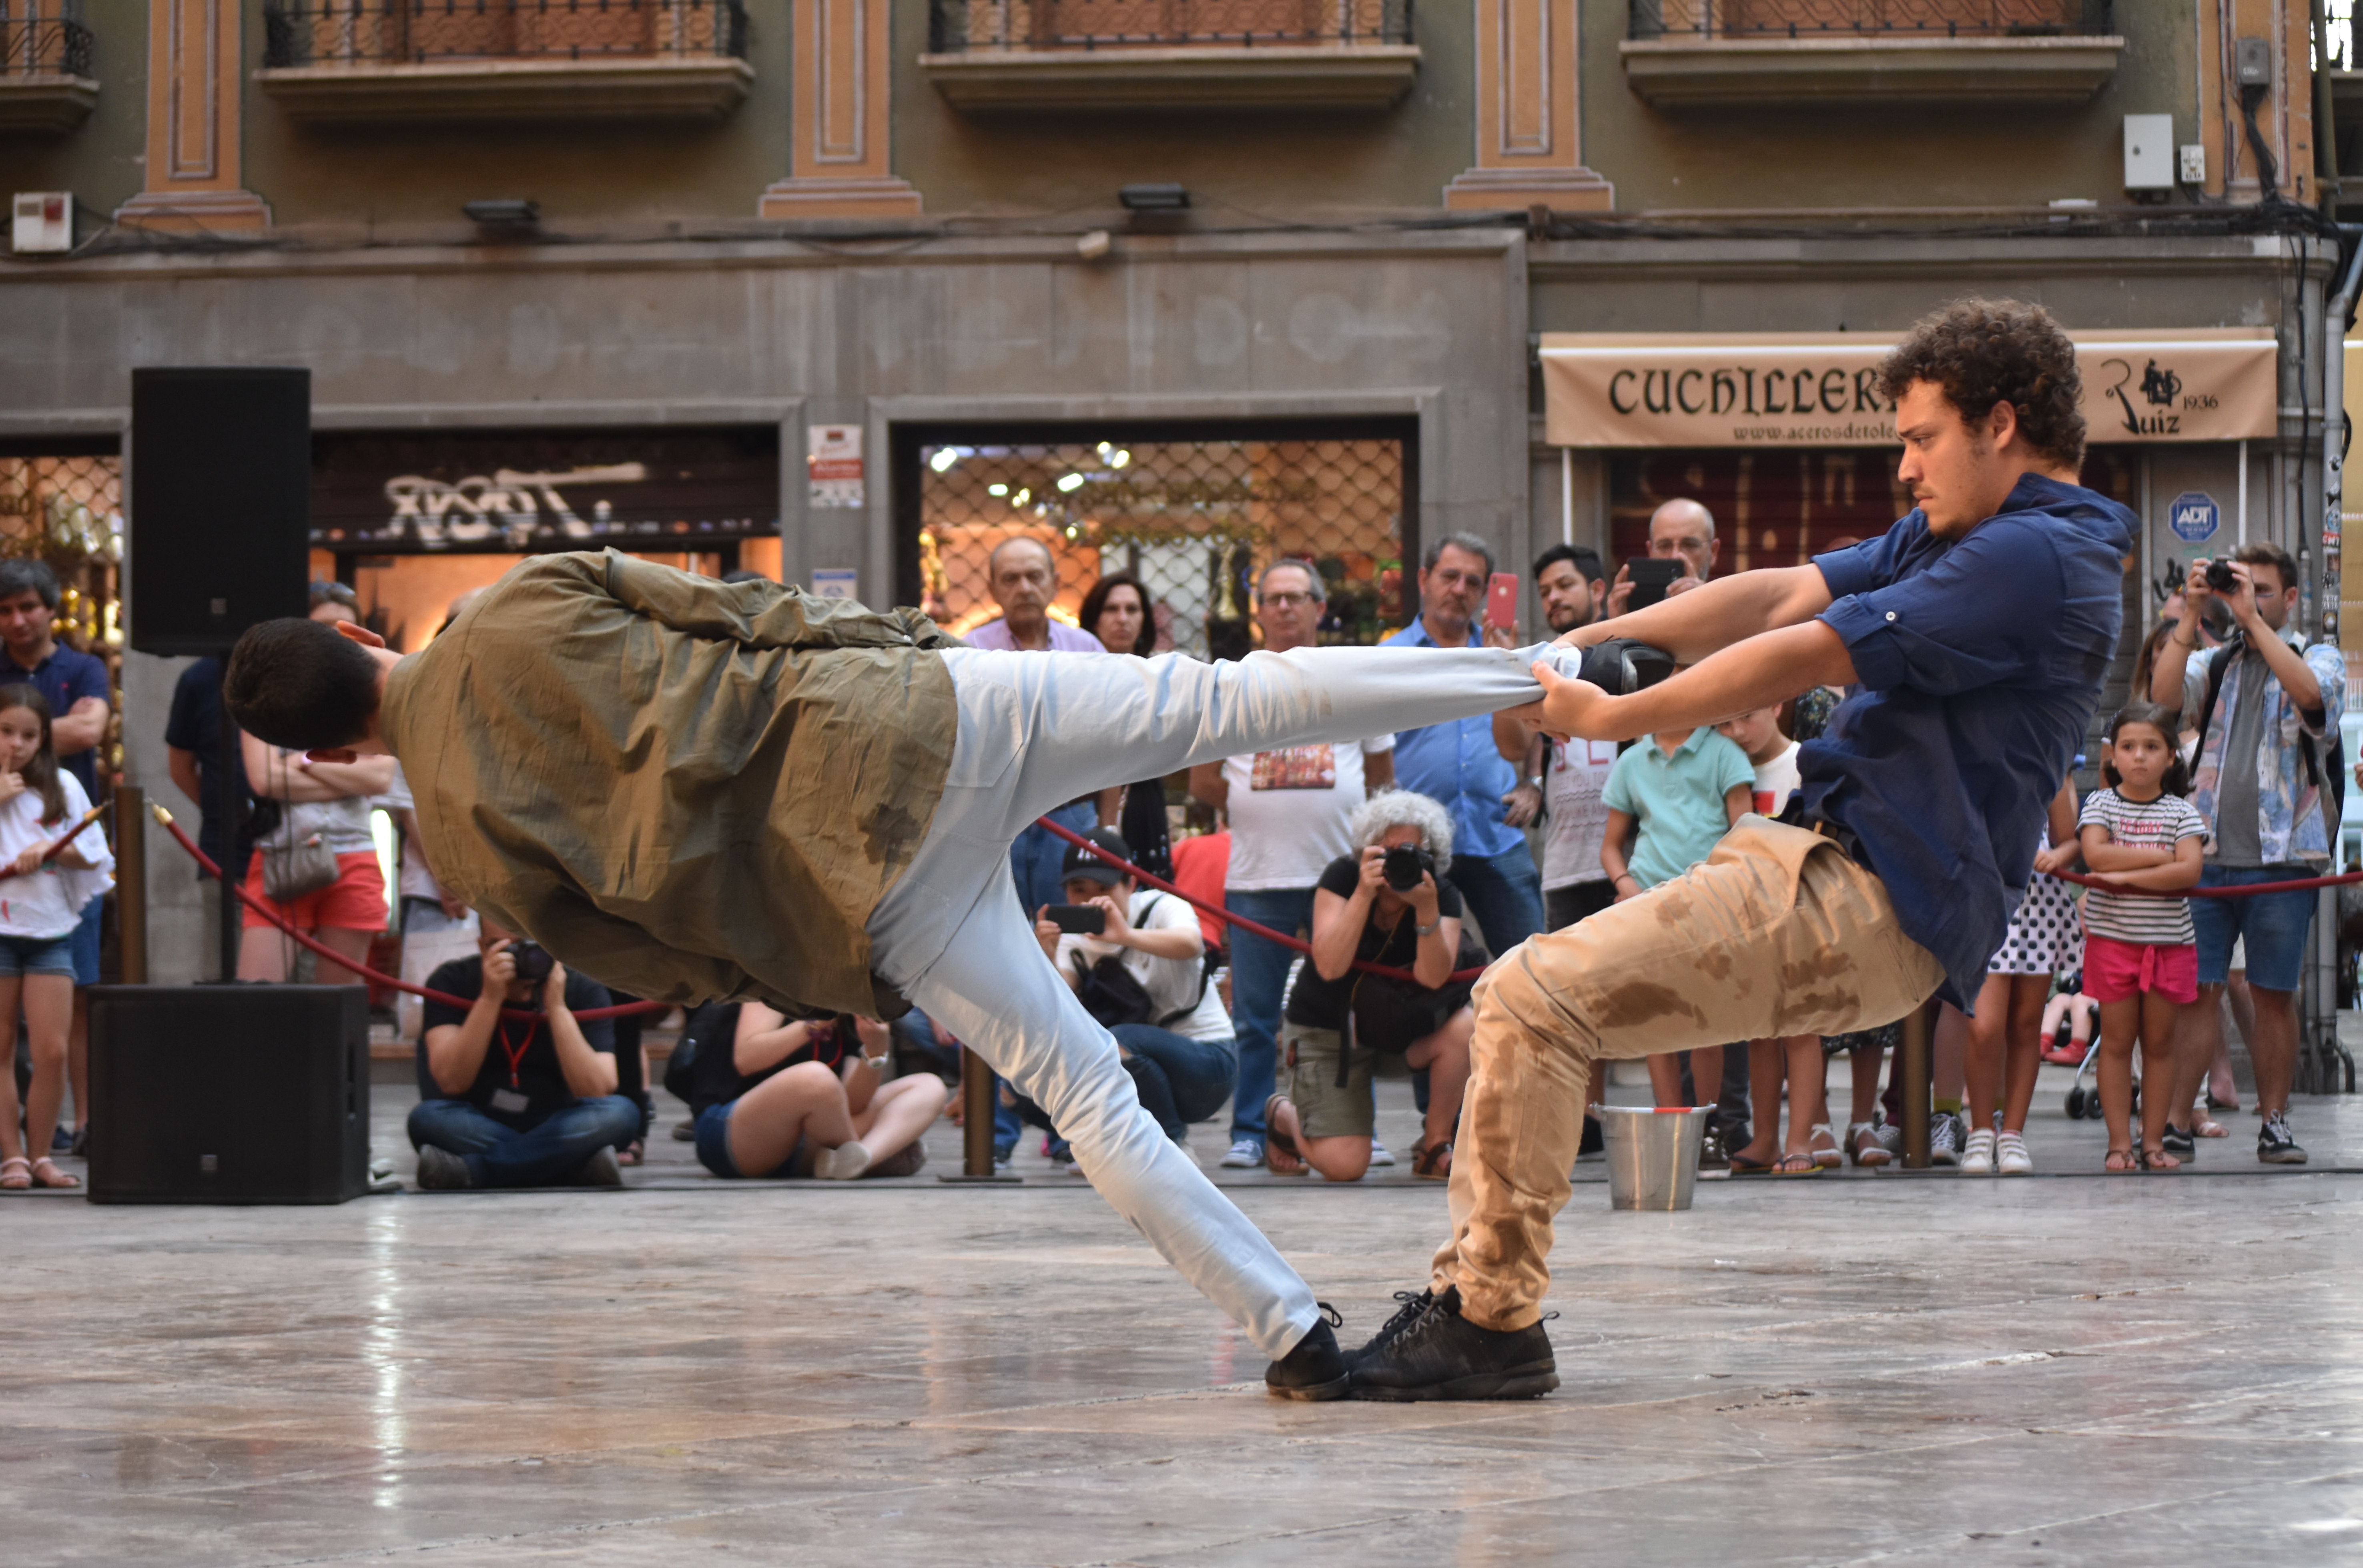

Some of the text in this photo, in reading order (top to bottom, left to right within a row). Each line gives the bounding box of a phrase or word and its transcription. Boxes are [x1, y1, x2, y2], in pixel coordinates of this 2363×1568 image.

[1609, 366, 1897, 416] CUCHILLER
[2183, 394, 2219, 410] 1936
[2177, 506, 2211, 523] ADT
